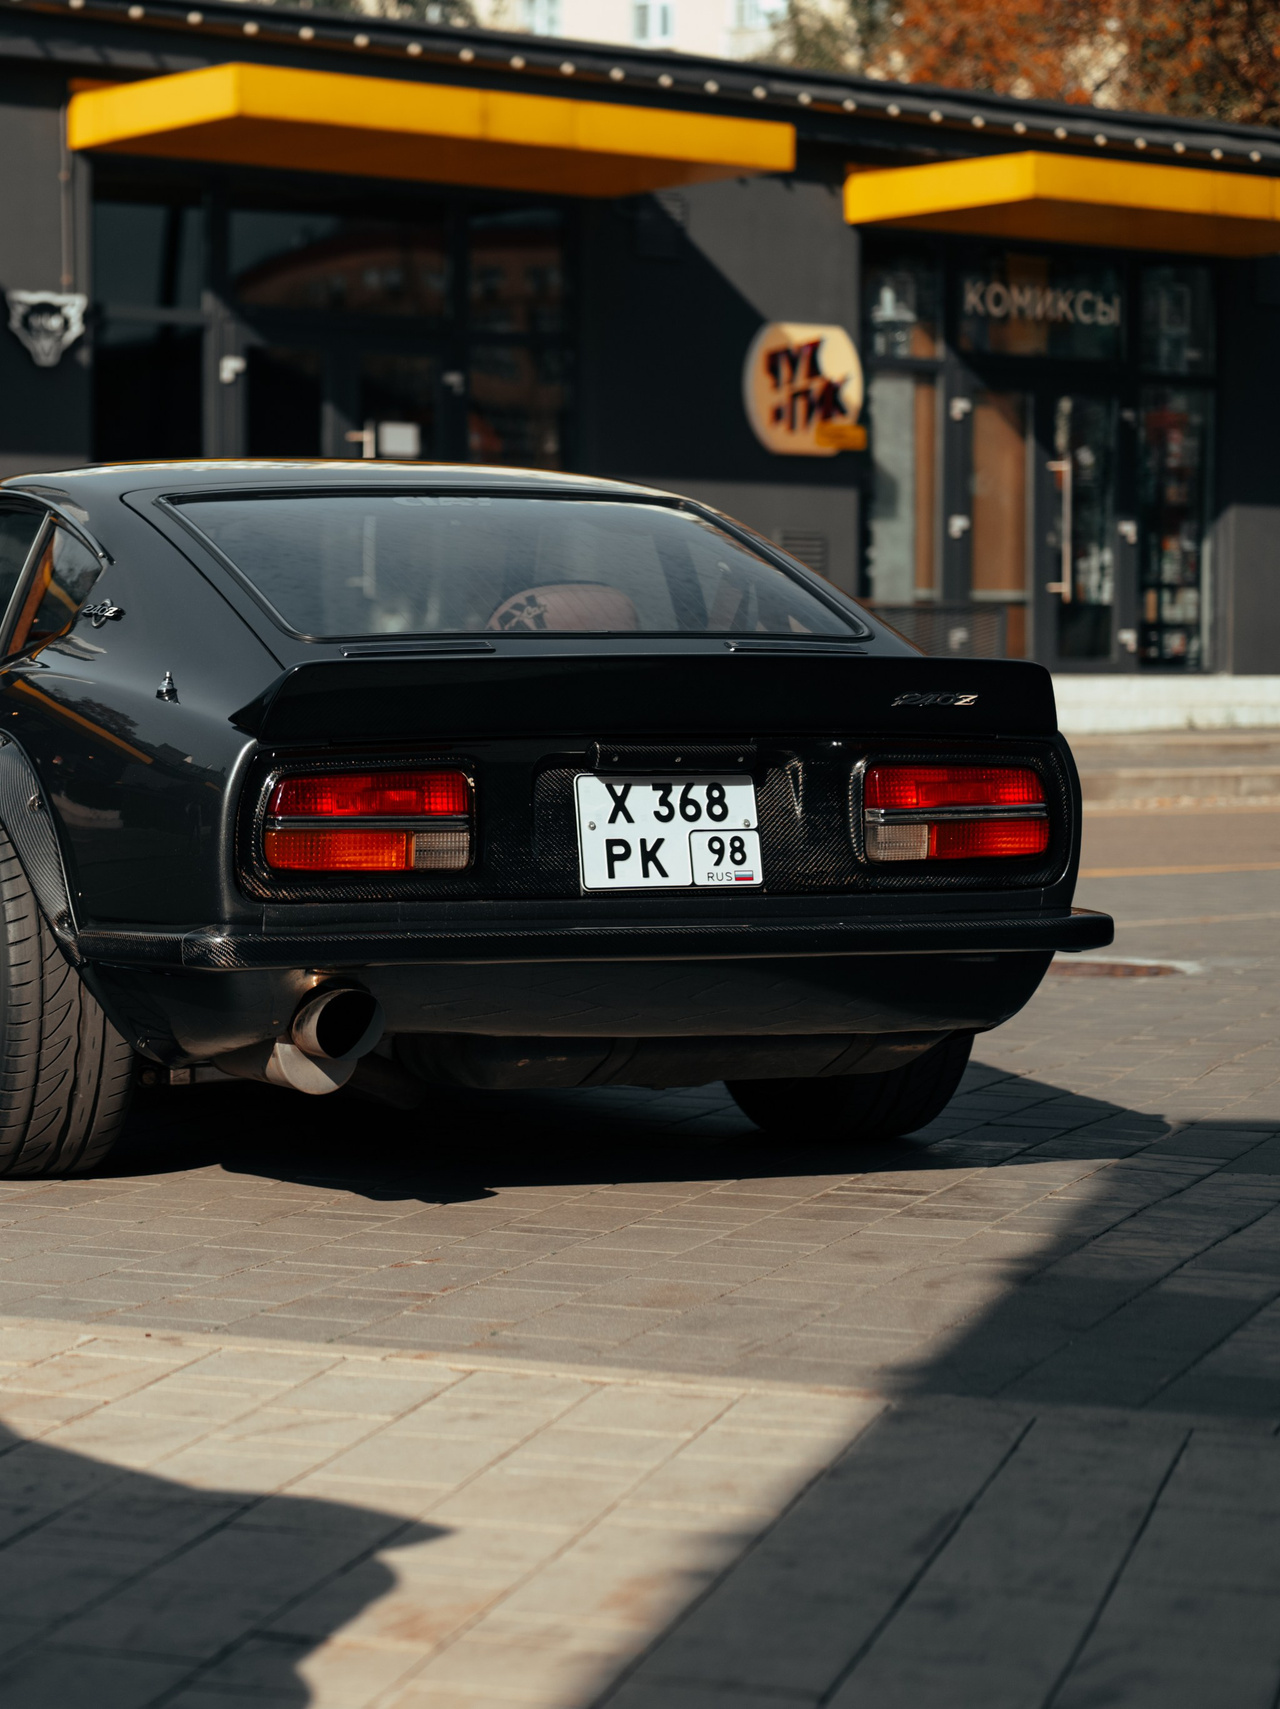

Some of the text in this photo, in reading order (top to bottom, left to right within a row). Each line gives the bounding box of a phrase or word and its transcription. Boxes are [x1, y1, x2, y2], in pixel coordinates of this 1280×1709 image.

[963, 279, 1120, 326] КОМИКСЫ
[82, 604, 118, 617] 240Z
[605, 782, 729, 824] X 368
[605, 836, 747, 879] PK 98
[707, 872, 733, 882] RUS
